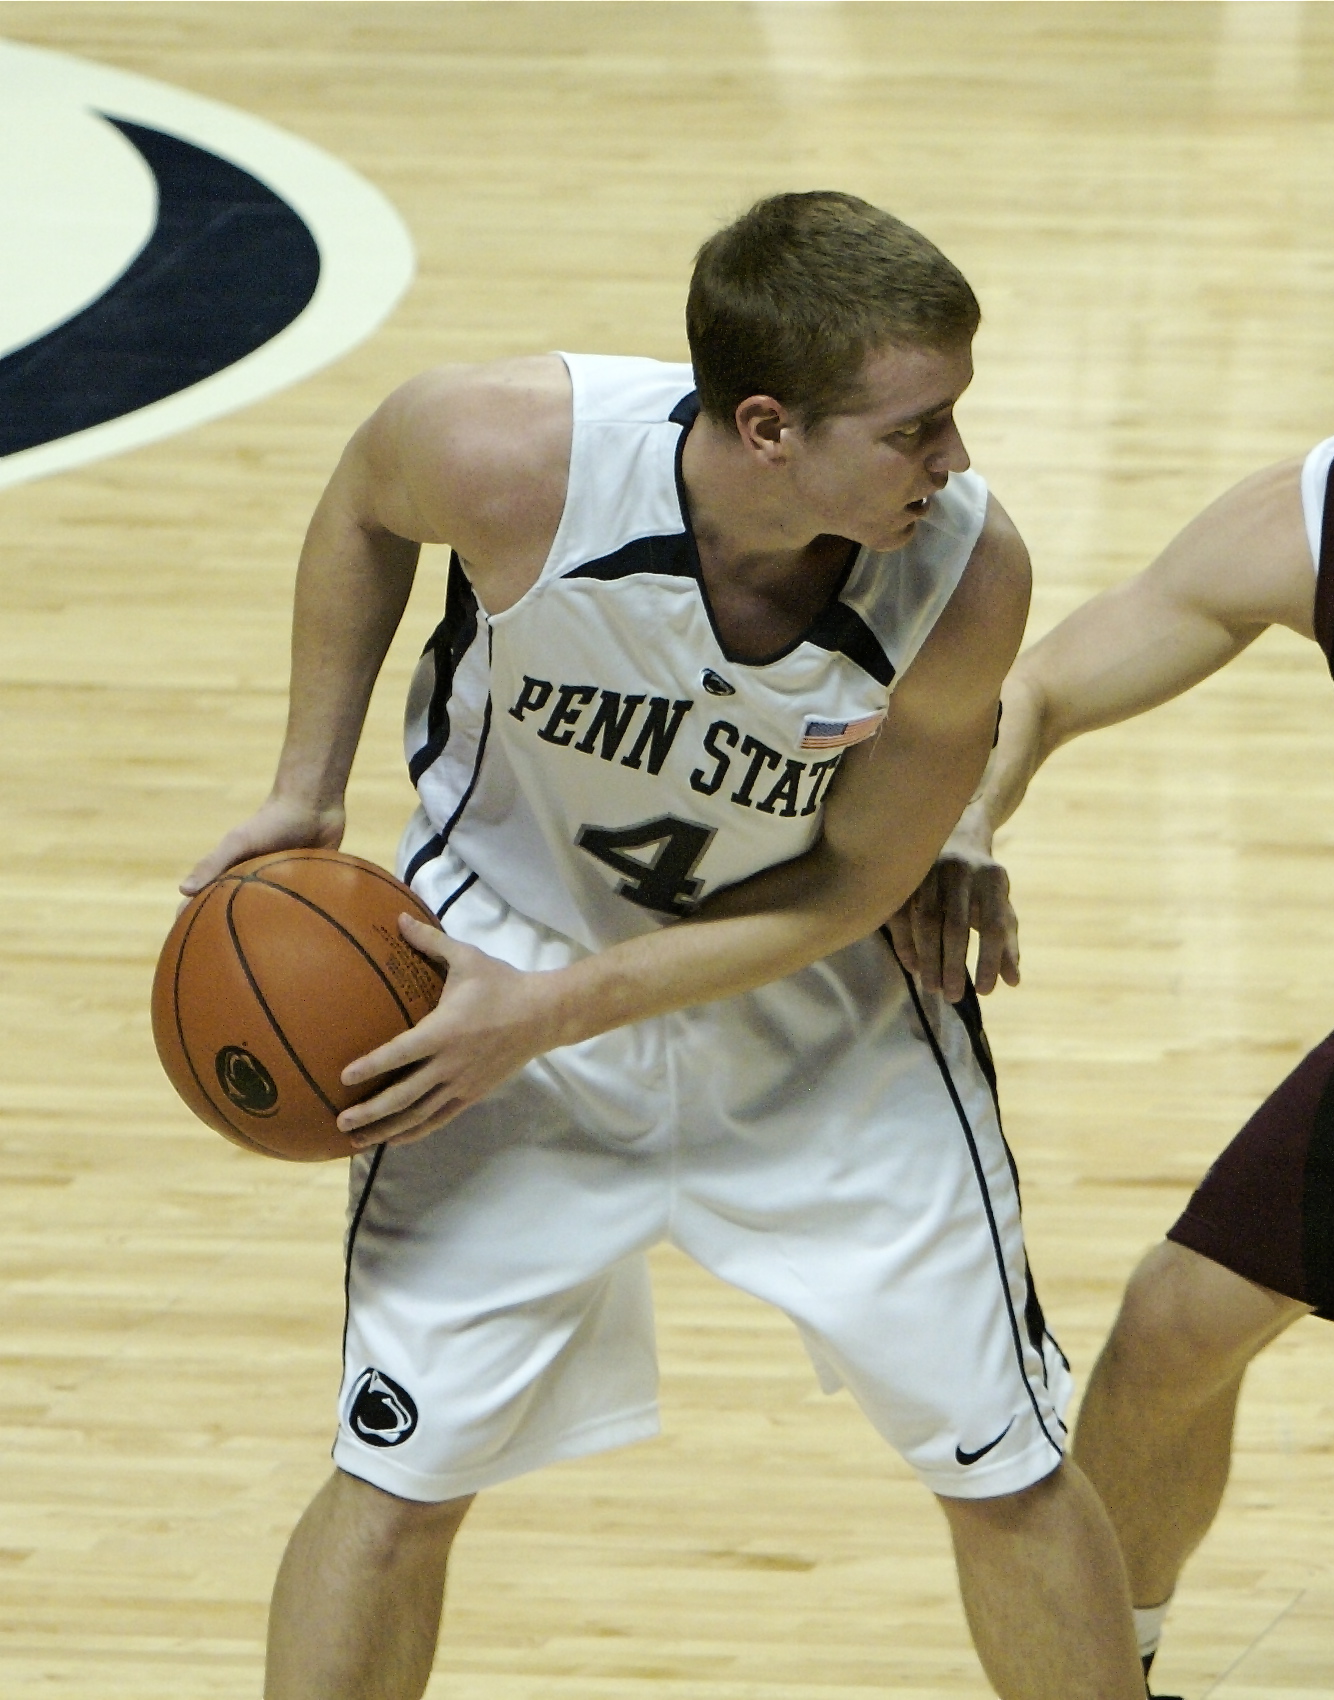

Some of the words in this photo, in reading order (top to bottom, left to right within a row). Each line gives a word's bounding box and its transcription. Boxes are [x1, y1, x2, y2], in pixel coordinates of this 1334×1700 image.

[508, 675, 694, 776] PENN
[689, 719, 845, 818] STAT
[573, 812, 718, 918] 4
